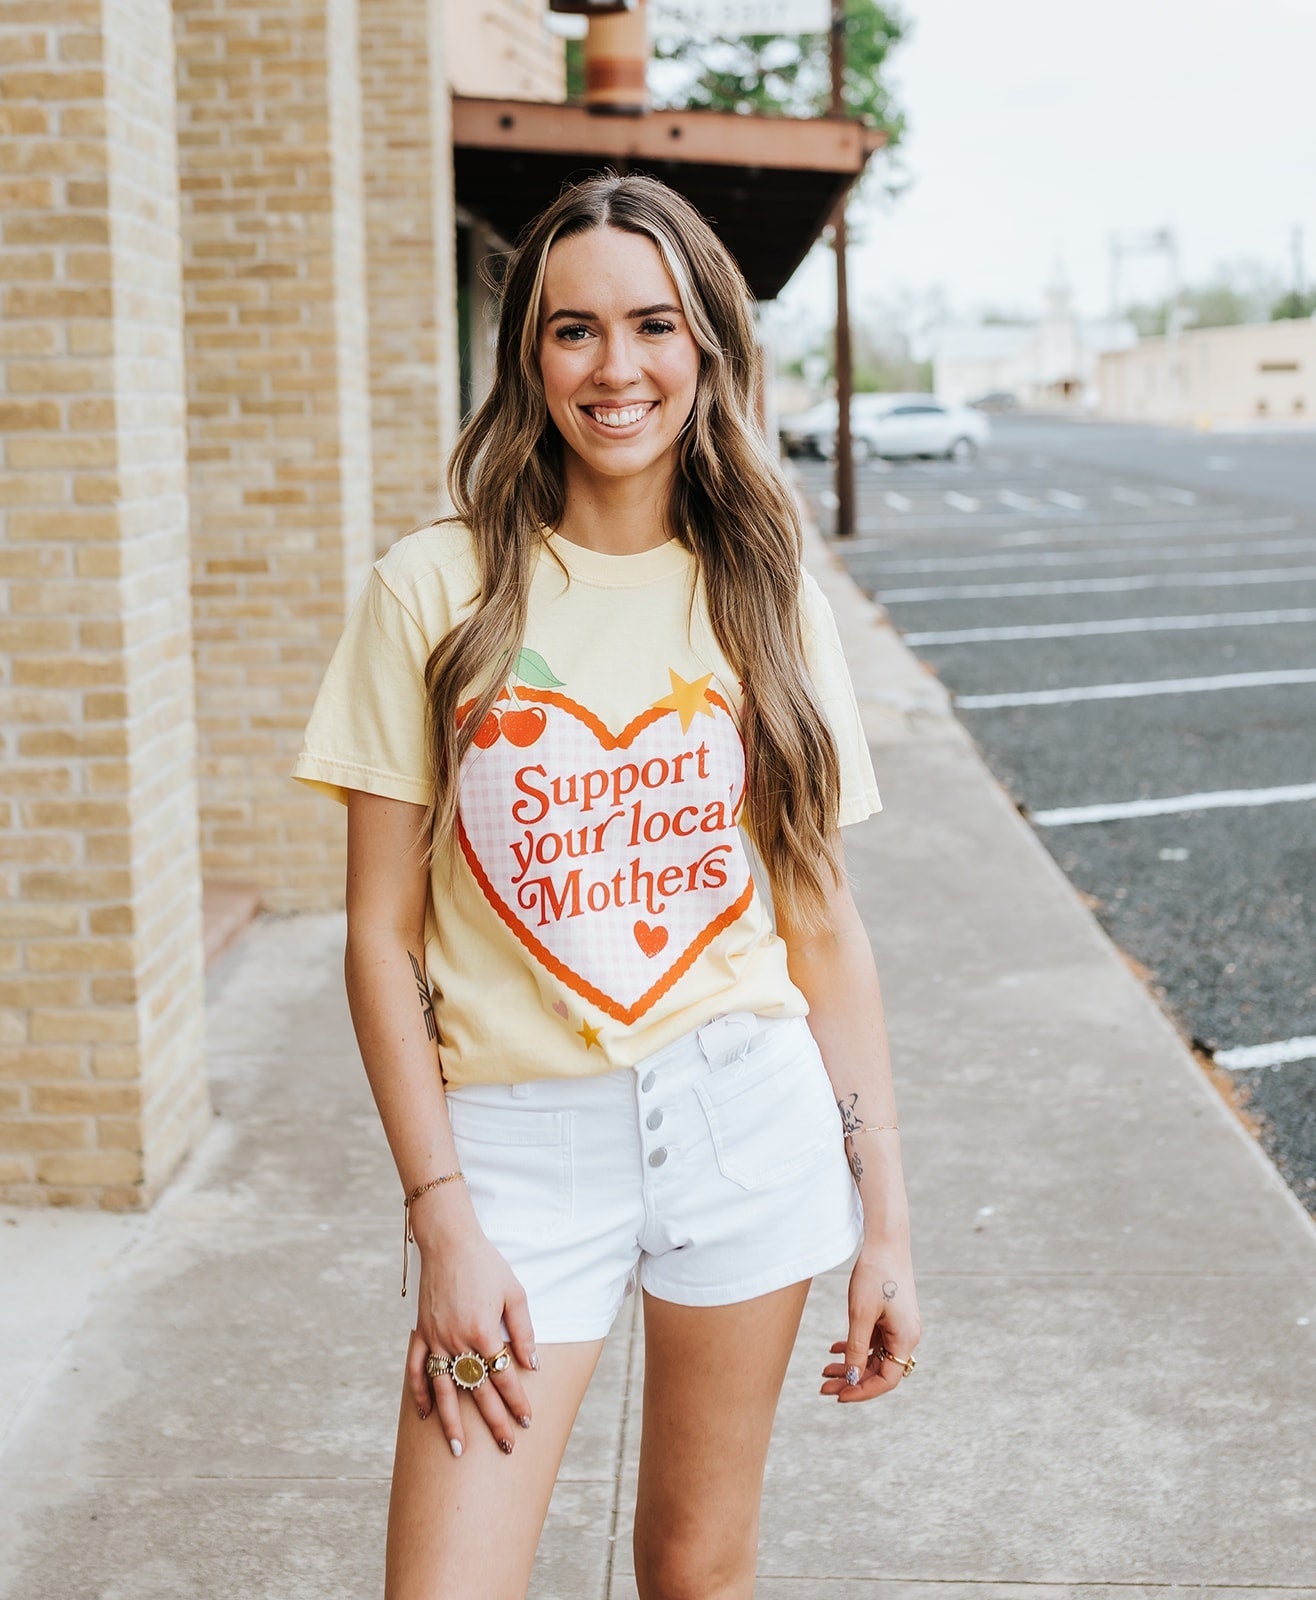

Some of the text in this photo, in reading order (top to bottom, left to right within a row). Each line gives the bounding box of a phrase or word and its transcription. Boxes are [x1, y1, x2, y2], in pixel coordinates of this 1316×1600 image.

[511, 740, 711, 826] Support
[508, 809, 626, 885] your
[516, 843, 733, 928] Mothers
